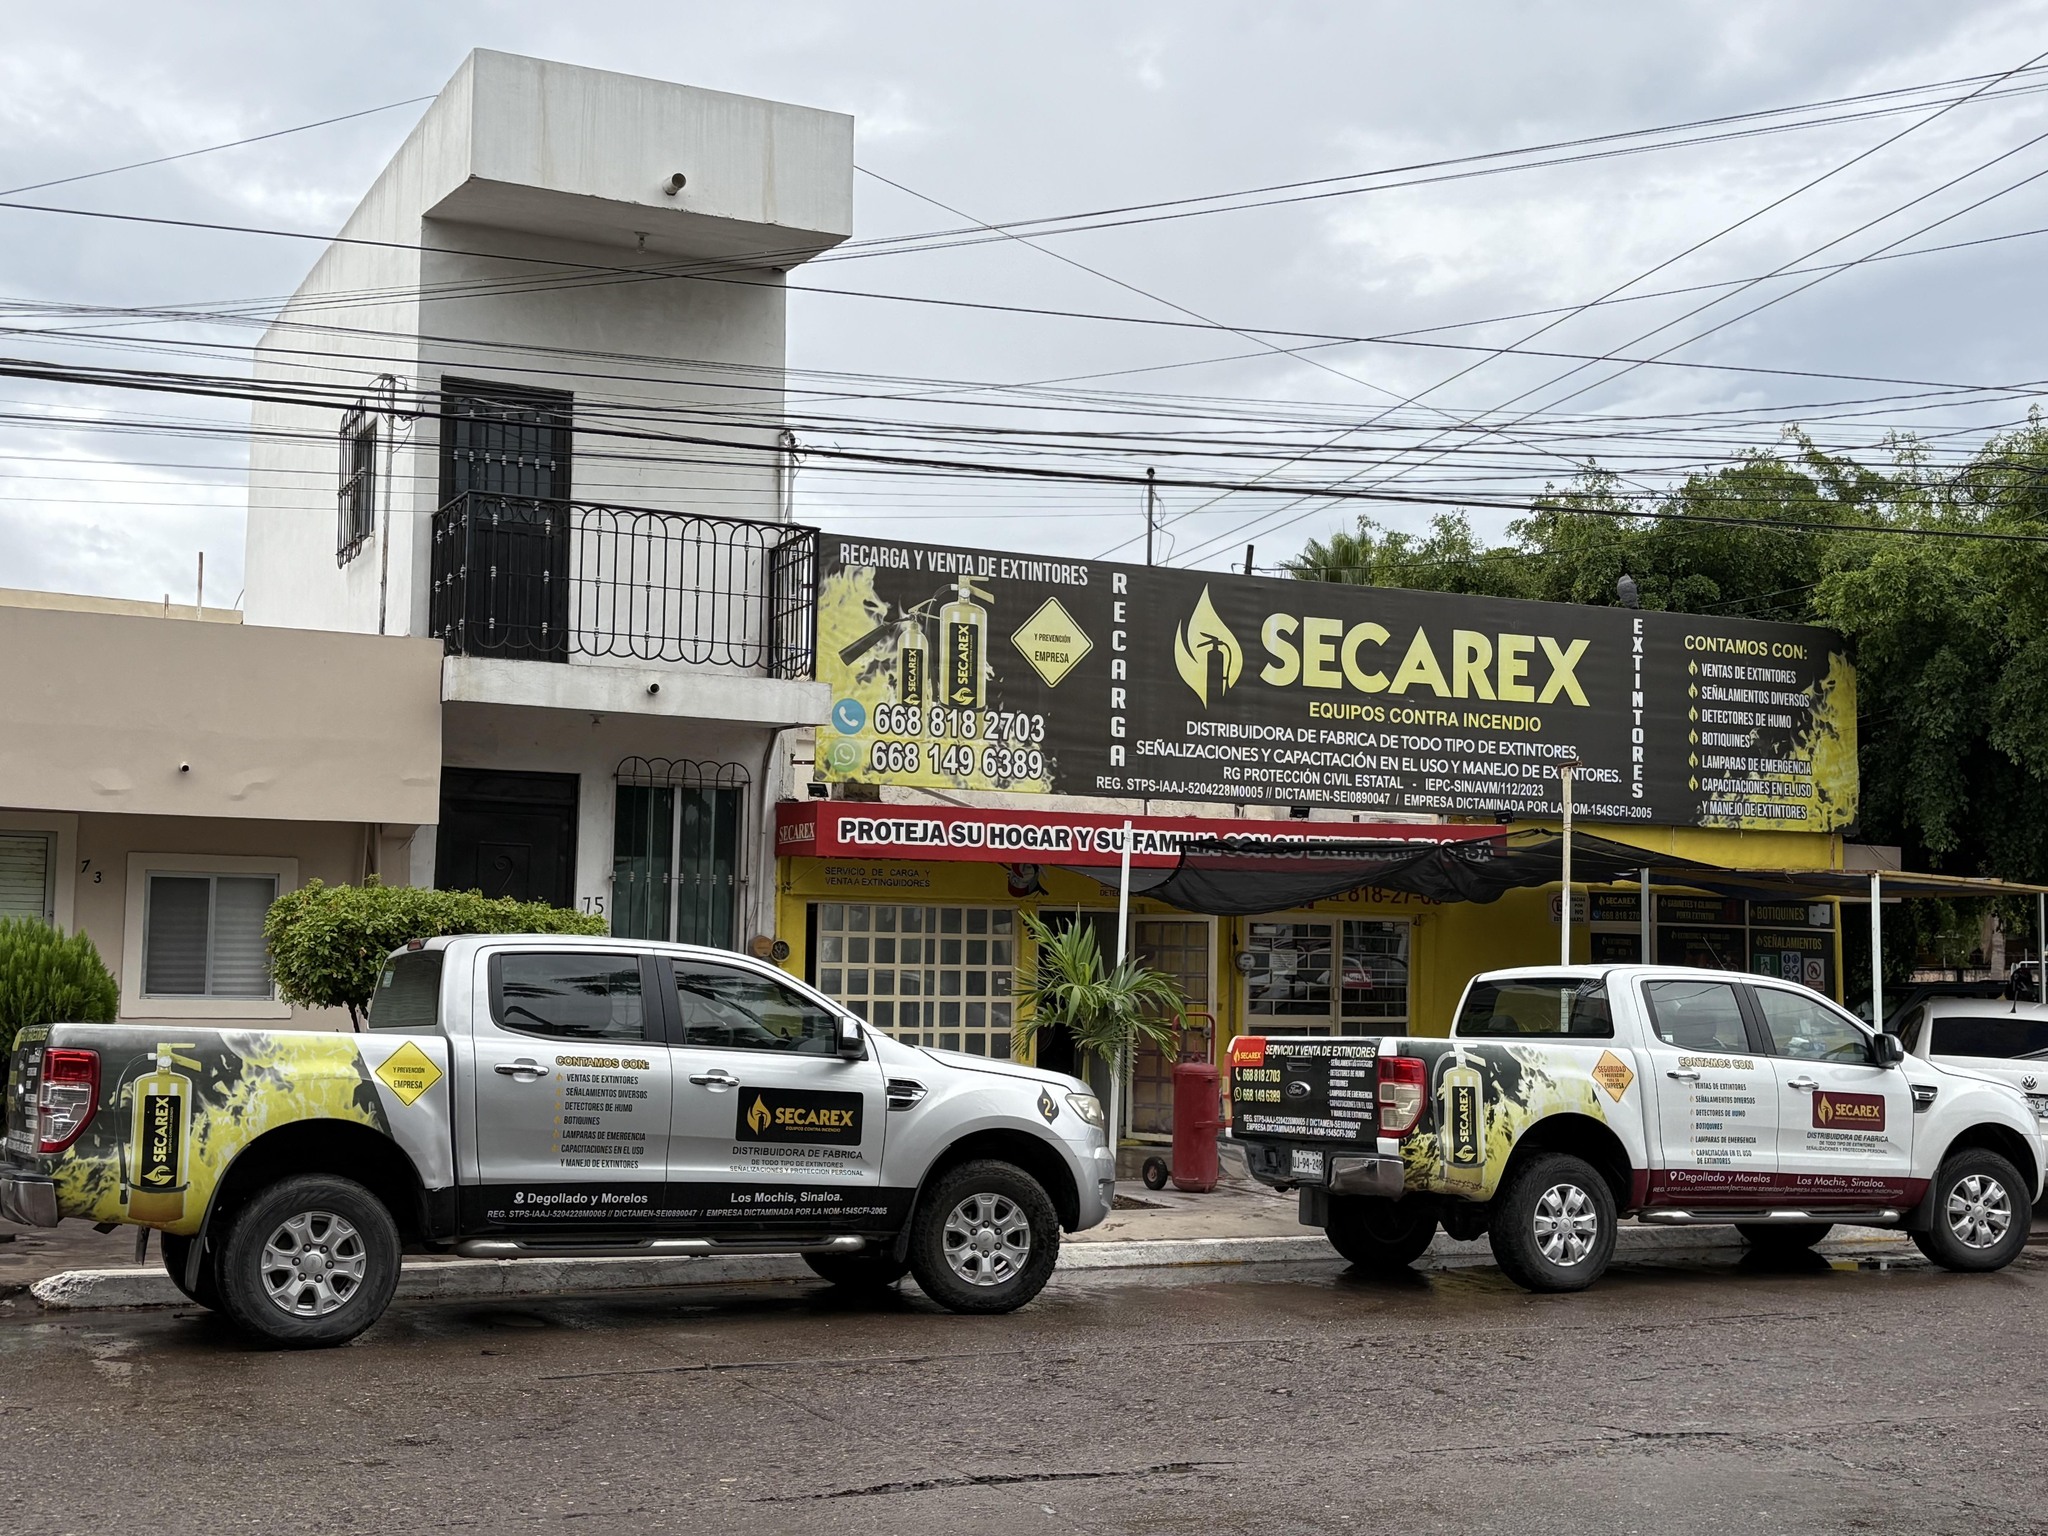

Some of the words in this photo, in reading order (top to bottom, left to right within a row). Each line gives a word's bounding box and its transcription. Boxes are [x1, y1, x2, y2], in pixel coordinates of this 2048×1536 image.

[840, 543, 909, 570] RECARGA
[912, 549, 924, 570] Y
[927, 551, 974, 576] VENTA
[978, 557, 997, 577] DE
[1000, 559, 1089, 587] EXTINTORES
[957, 624, 969, 685] SECAREX
[1684, 635, 1768, 657] CONTAMOS
[1772, 643, 1808, 660] CON:
[1034, 650, 1070, 664] EMPRESA
[1259, 612, 1591, 707] SECAREX
[908, 649, 917, 693] SECAREX
[1110, 572, 1128, 767] RECARGA
[1702, 663, 1733, 679] VENTAS
[1734, 667, 1746, 680] DE
[1747, 667, 1797, 684] EXTINTORES
[1702, 684, 1769, 704] SEÑALAMIENTOS
[1771, 691, 1810, 708] DIVERSOS
[1309, 702, 1385, 722] EQUIPOS
[1390, 707, 1459, 727] CONTRA
[1463, 713, 1542, 732] INCENDIO
[1632, 618, 1644, 799] EXTINTORES
[875, 703, 922, 735] 668
[930, 708, 977, 738] 818
[984, 712, 1045, 743] 2703
[1702, 709, 1753, 726] DETECTORES
[1755, 712, 1767, 727] DE
[1768, 713, 1792, 729] HUMO
[1186, 721, 1294, 742] DISTRIBUIDORA
[1297, 728, 1316, 742] DE
[1320, 730, 1377, 747] FABRICA
[1380, 734, 1399, 749] DE
[1401, 735, 1442, 751] TODO
[1444, 738, 1475, 754] TIPO
[1478, 740, 1496, 755] DE
[1499, 742, 1580, 760] EXTINTORES,
[1702, 732, 1750, 748] BOTIQUINES
[872, 741, 920, 772] 668
[928, 745, 975, 776] 149
[982, 749, 1043, 779] 6389
[1136, 738, 1258, 761] SEÑALIZACIONES
[1261, 748, 1271, 761] Y
[1273, 748, 1377, 769] CAPACITACIÓN
[1380, 757, 1399, 771] EN
[1402, 758, 1418, 772] EL
[1420, 759, 1449, 773] USO
[1451, 761, 1460, 773] Y
[1463, 761, 1519, 777] MANEJO
[1522, 764, 1540, 778] DE
[1543, 765, 1622, 783] EXNTORES.
[1702, 755, 1746, 771] LAMPARAS
[1748, 757, 1759, 772] DE
[1760, 759, 1812, 775] EMERGENCIA
[1223, 766, 1241, 780] RG
[1244, 768, 1321, 785] PROTECCIÓN
[1323, 772, 1352, 786] CIVIL
[1355, 774, 1404, 789] ESTATAL
[1425, 778, 1544, 797] IEPC-SIN/AVM/112/2023
[1702, 778, 1770, 795] CAPACITACIONES
[1772, 781, 1783, 795] EN
[1784, 782, 1794, 796] EL
[1795, 782, 1812, 797] USO
[1096, 776, 1124, 790] REG.
[1127, 778, 1264, 799] STPS-IAAJ-5204228M0005
[1404, 794, 1453, 809] EMPRESA
[1456, 796, 1525, 812] DICTAMINADA
[1527, 800, 1548, 814] POR
[1550, 802, 1563, 814] LA
[1569, 803, 1652, 819] OM-154SCFI-2005
[1702, 801, 1709, 814] Y
[1710, 801, 1742, 816] MANEJO
[1744, 804, 1756, 817] DE
[1757, 804, 1807, 819] EXTINTORES
[778, 821, 816, 843] SECAREX
[838, 818, 945, 844] PROTEJA
[951, 823, 984, 845] SU
[989, 826, 1070, 849] HOGAR
[1076, 829, 1092, 849] Y
[1096, 830, 1126, 851] SU
[825, 867, 866, 877] SERVICIO
[871, 868, 884, 877] DE
[890, 868, 920, 878] CARGA
[825, 877, 851, 887] VENTA
[861, 878, 930, 888] EXTINGUIDORES
[582, 896, 604, 914] 75
[1757, 906, 1805, 921] BOTIQUINES
[1762, 934, 1822, 950] SEÑALAMIENTOS
[1240, 1051, 1261, 1059] SECAREX
[1265, 1045, 1294, 1057] SERVICIO
[1301, 1045, 1320, 1056] VENTA
[1322, 1046, 1331, 1056] DE
[1332, 1046, 1376, 1058] EXTINTORES
[556, 1056, 619, 1068] CONTAMOS
[621, 1059, 650, 1070] CON:
[394, 1080, 423, 1089] EMPRESA
[566, 1073, 590, 1083] VENTAS
[592, 1075, 600, 1083] DE
[601, 1075, 638, 1085] EXTINTORES
[566, 1087, 617, 1098] SEÑALAMIENTOS
[618, 1090, 647, 1099] DIVERSOS
[565, 1102, 604, 1111] DETECTORES
[605, 1103, 613, 1112] DE
[614, 1104, 633, 1112] HUMO
[1043, 1098, 1053, 1116] 2
[1460, 1088, 1469, 1143] SECAREX
[1835, 1104, 1880, 1117] SECAREX
[564, 1116, 600, 1126] BOTIQUINES
[775, 1107, 854, 1127] SECAREX
[153, 1096, 169, 1163] SECAREX
[563, 1130, 597, 1140] LAMPARAS
[597, 1131, 606, 1140] DE
[607, 1131, 646, 1141] EMERGENCIA
[561, 1144, 613, 1154] CAPACITACIONES
[613, 1146, 622, 1154] EN
[623, 1146, 631, 1155] EL
[632, 1146, 644, 1155] USO
[732, 1146, 806, 1157] DISTRIBUIDORA
[808, 1149, 820, 1157] DE
[822, 1150, 863, 1159] FABRICA
[566, 1159, 591, 1167] MANEJO
[592, 1159, 600, 1168] DE
[601, 1160, 639, 1169] EXTINTORES
[1678, 1172, 1725, 1183] Degollado
[1735, 1173, 1771, 1183] Morelos
[1797, 1176, 1812, 1185] Los
[1814, 1177, 1848, 1188] Mochis,
[1851, 1178, 1886, 1188] Sinaloa.
[527, 1193, 588, 1206] Degollado
[590, 1195, 598, 1206] y
[601, 1193, 648, 1203] Morelos
[731, 1192, 751, 1203] Los
[755, 1192, 797, 1204] Mochis,
[800, 1191, 843, 1202] Sinaloa.
